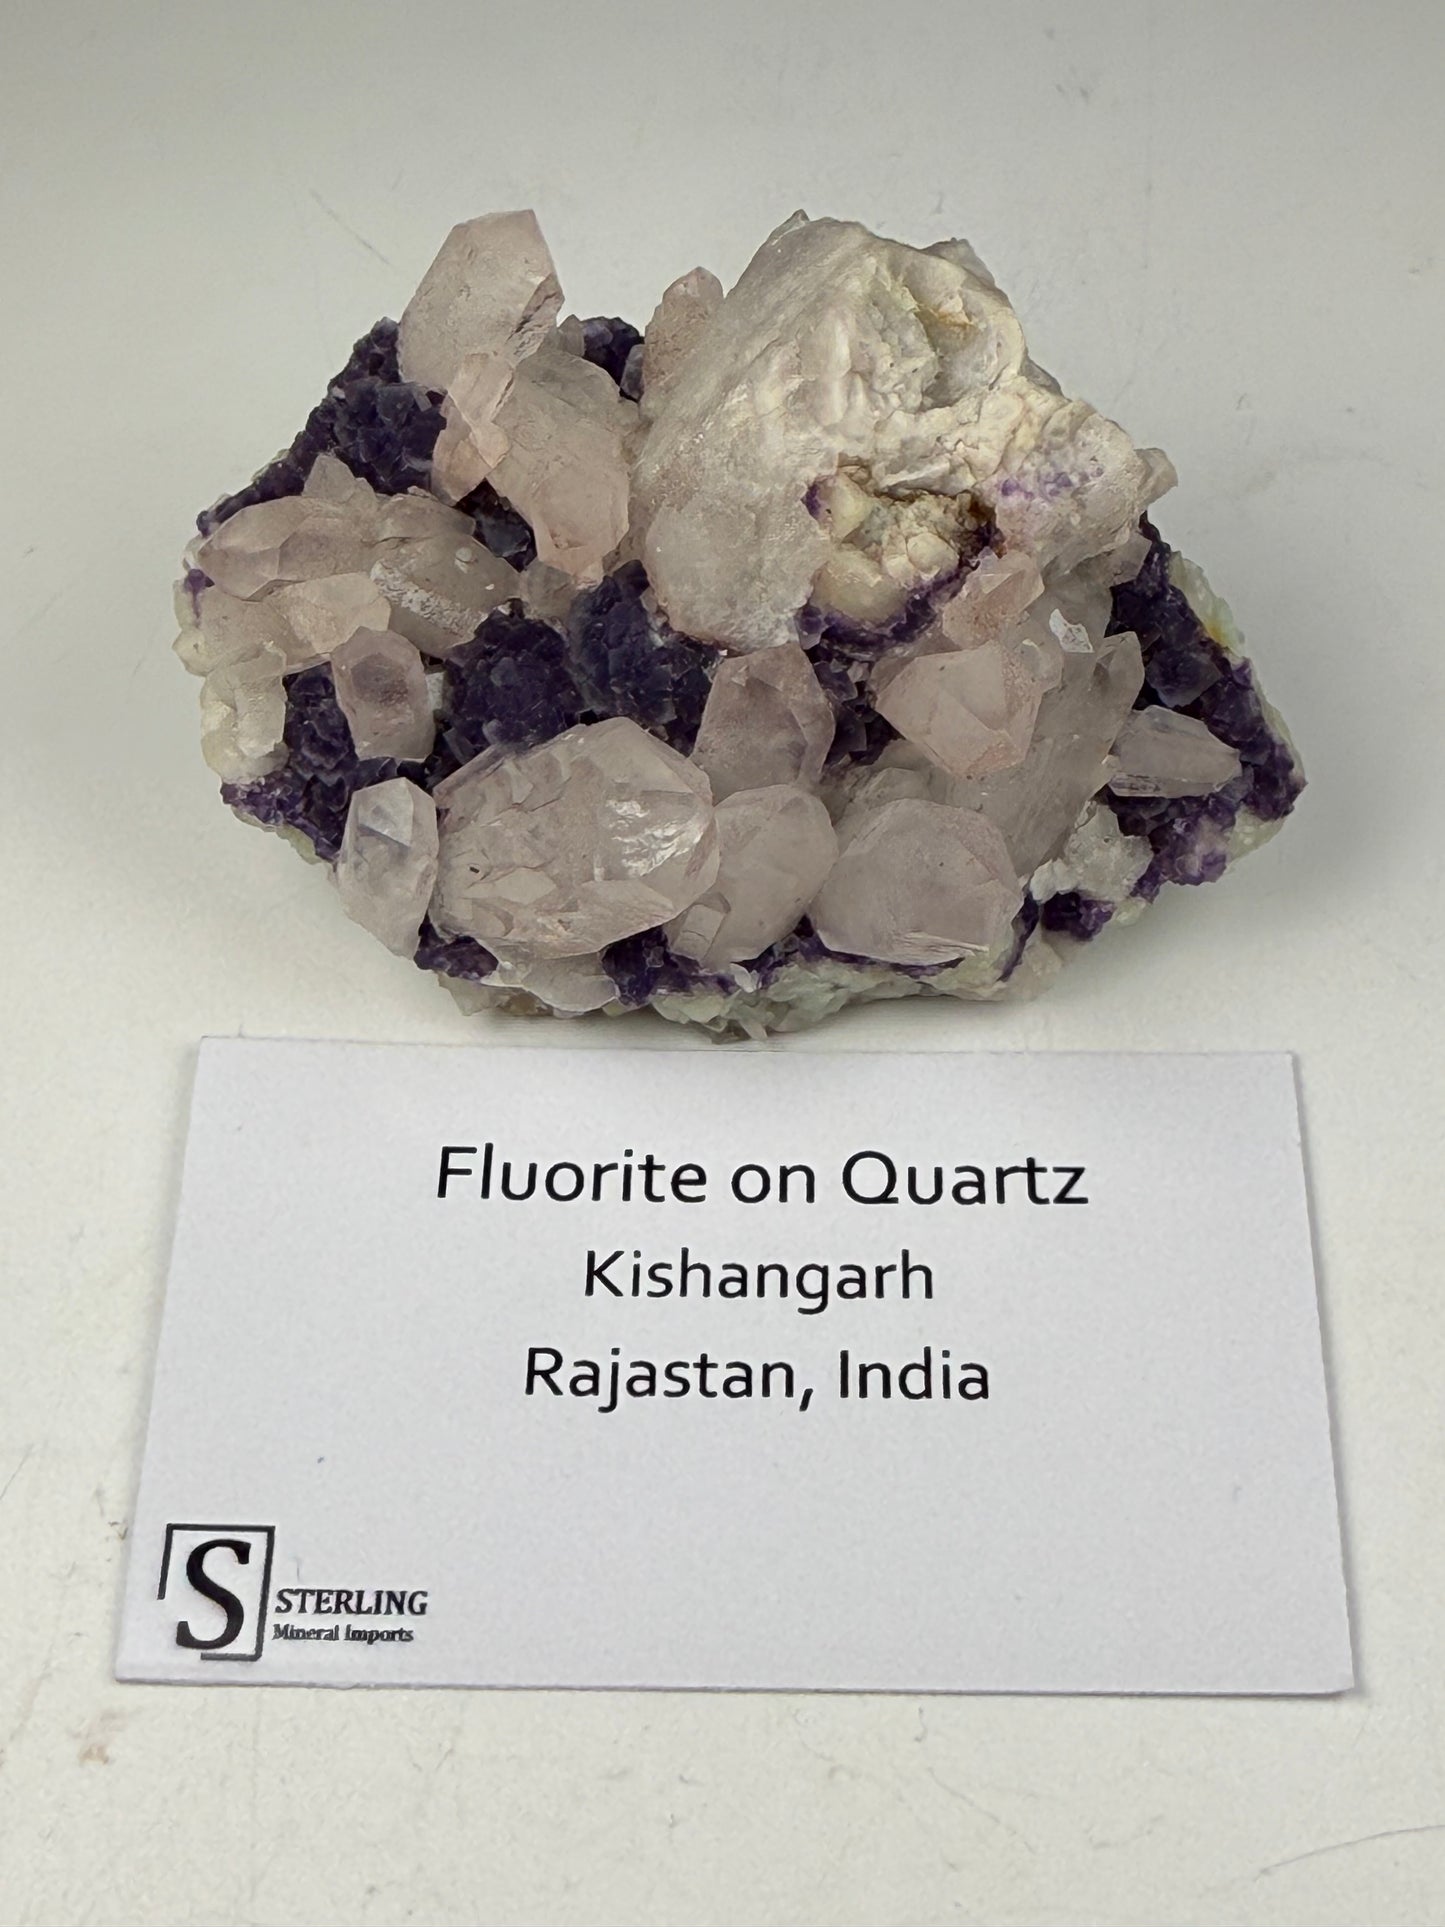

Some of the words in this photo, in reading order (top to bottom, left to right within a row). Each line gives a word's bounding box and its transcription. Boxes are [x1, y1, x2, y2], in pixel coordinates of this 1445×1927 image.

[437, 1142, 707, 1204] Fluorite
[730, 1163, 815, 1204] on
[842, 1150, 1089, 1206] Quartz
[584, 1246, 933, 1316] Kishangarh
[525, 1347, 814, 1414] Rajastan,
[839, 1346, 989, 1401] India
[175, 1538, 252, 1651] S
[274, 1588, 428, 1616] STERLING
[272, 1623, 340, 1642] Mineral
[343, 1624, 414, 1646] Imports
